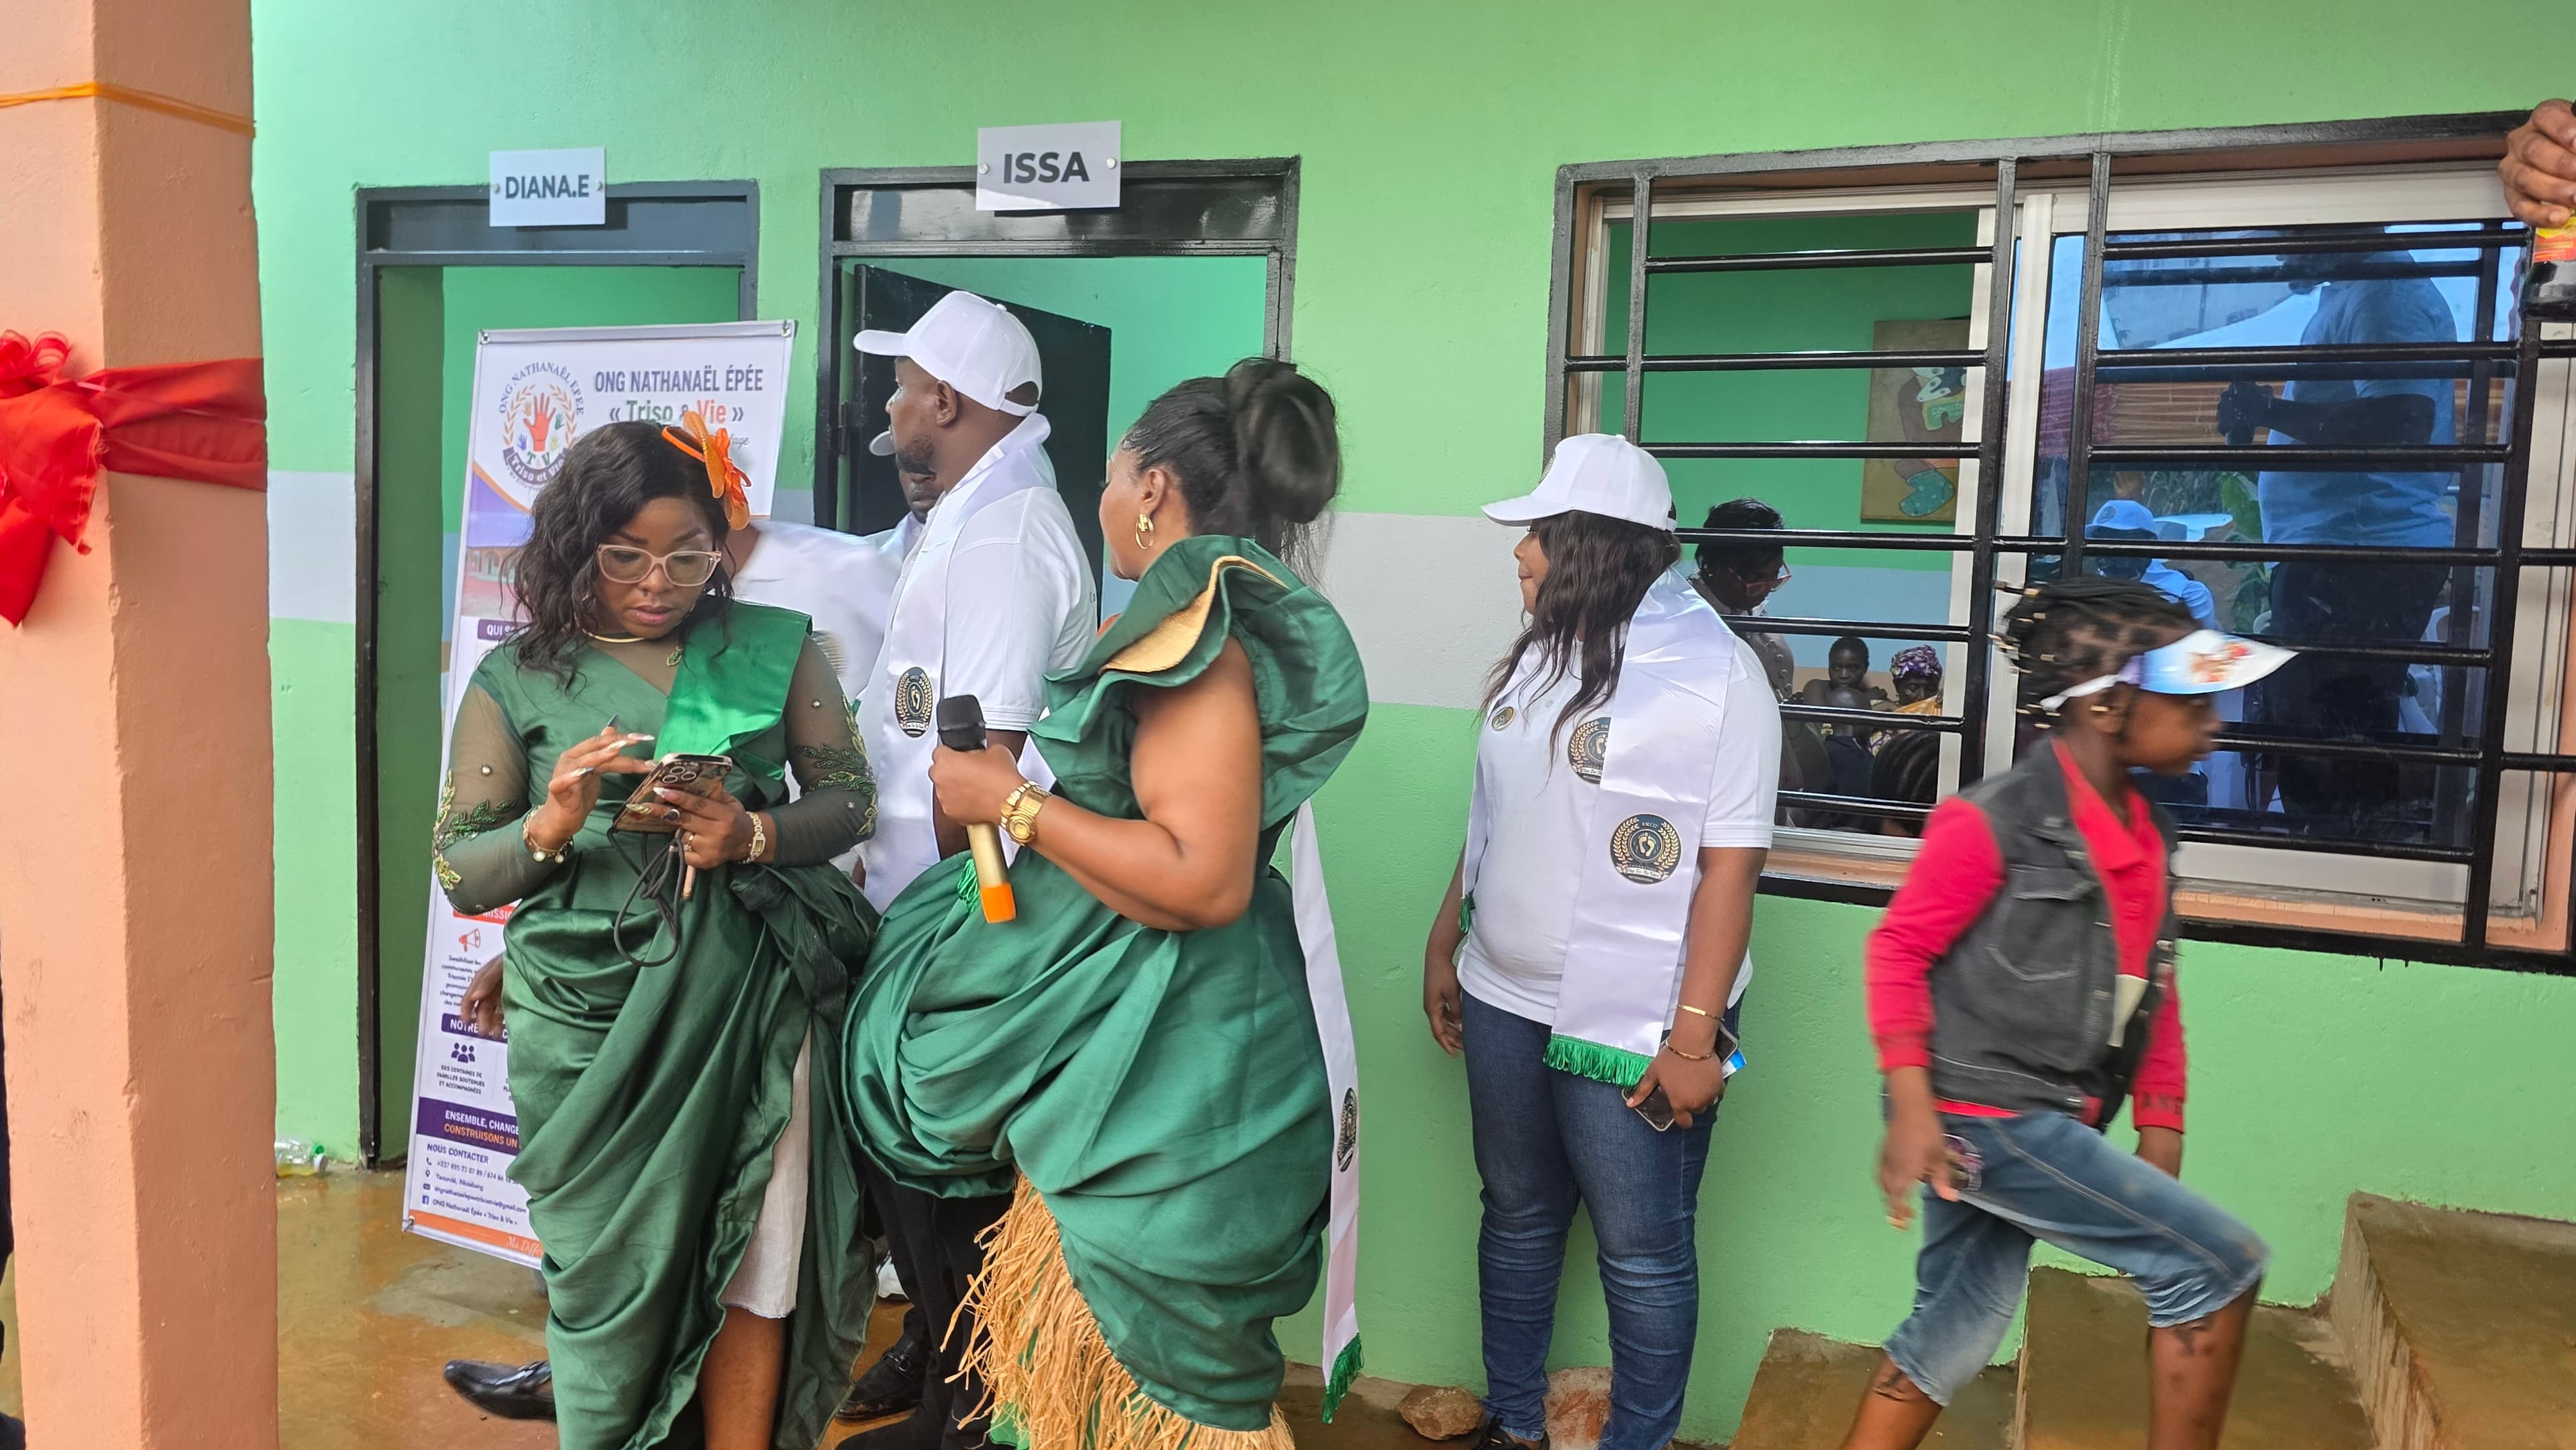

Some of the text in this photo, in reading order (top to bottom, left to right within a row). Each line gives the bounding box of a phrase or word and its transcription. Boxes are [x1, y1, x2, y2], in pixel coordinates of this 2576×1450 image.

[1004, 152, 1090, 184] ISSA
[505, 174, 590, 199] DIANA.E
[595, 364, 763, 392] ONG NATHANAËL ÉPÉE
[499, 384, 513, 413] ONG
[627, 400, 674, 423] Triso
[697, 399, 727, 424] Vie
[487, 624, 502, 636] QUI
[445, 1110, 488, 1129] ENSEMBLE,
[444, 1123, 518, 1148] CONSTRUISONS UN
[427, 1144, 489, 1164] NOUS CONTACTER
